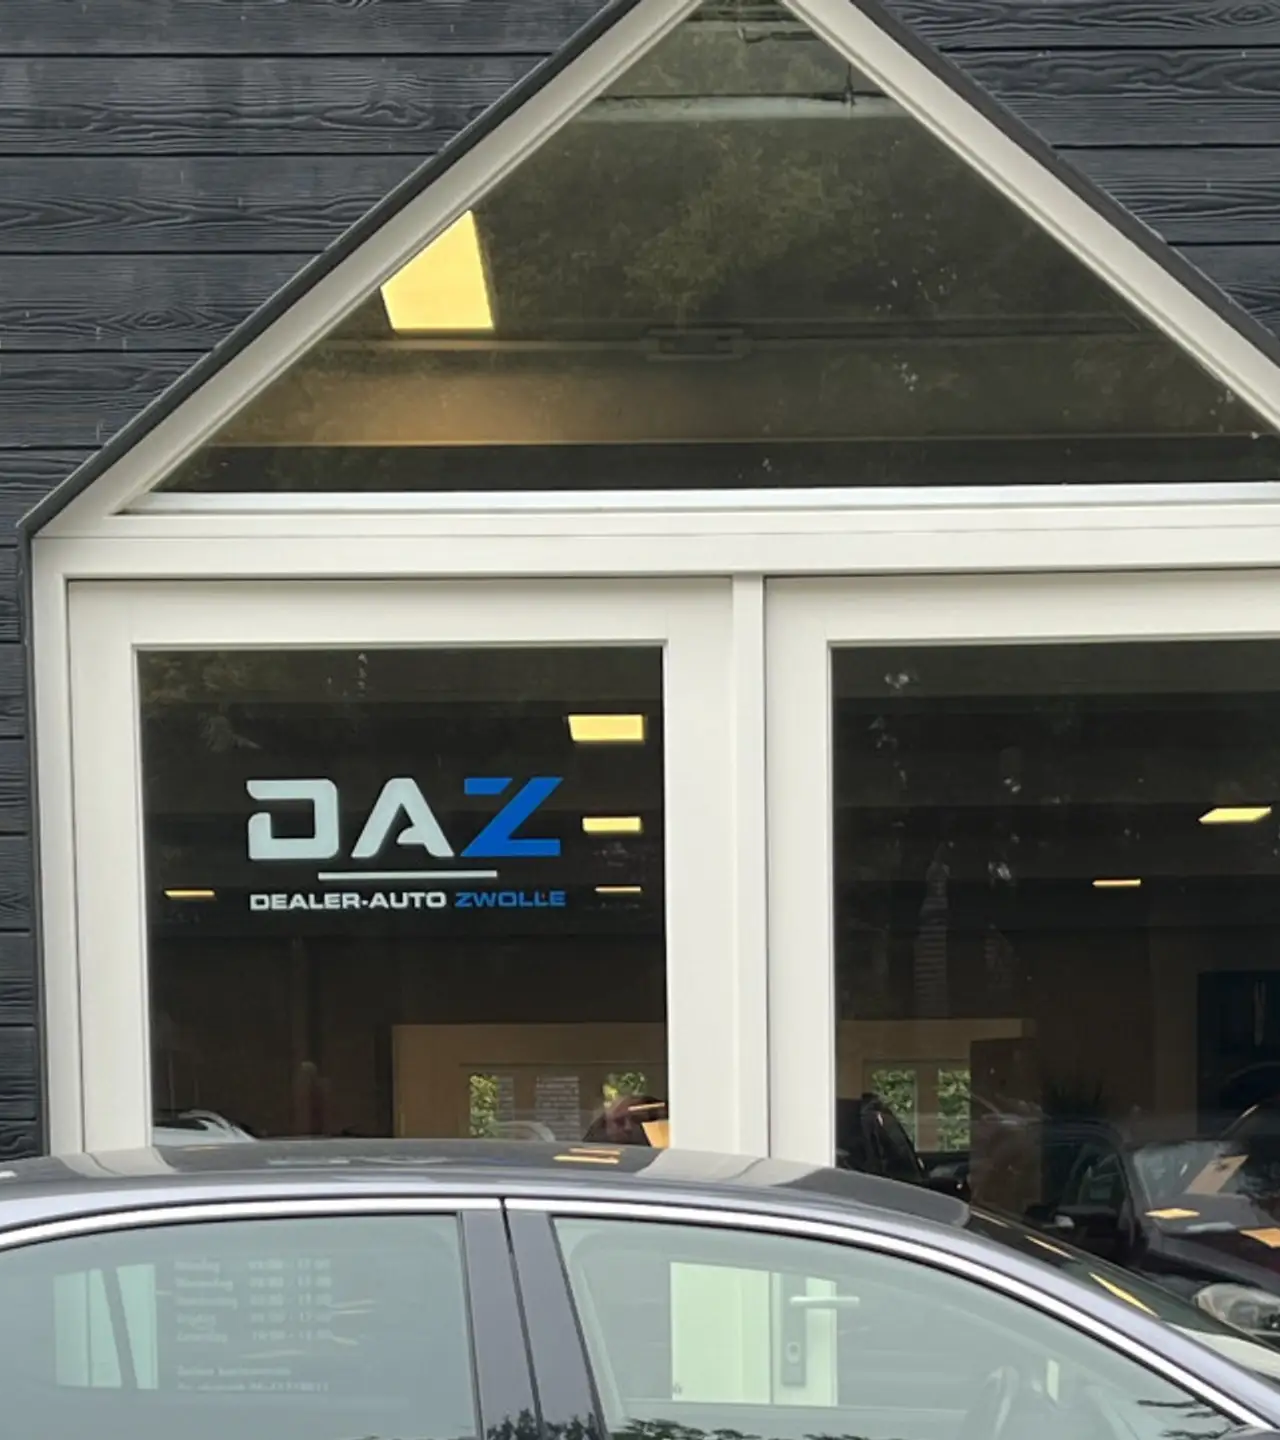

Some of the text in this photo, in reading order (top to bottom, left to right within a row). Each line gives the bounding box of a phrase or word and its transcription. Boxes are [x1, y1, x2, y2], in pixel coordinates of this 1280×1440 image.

[246, 777, 563, 860] DAZ
[250, 891, 566, 910] DEALER-AUTO ZWOLLE
